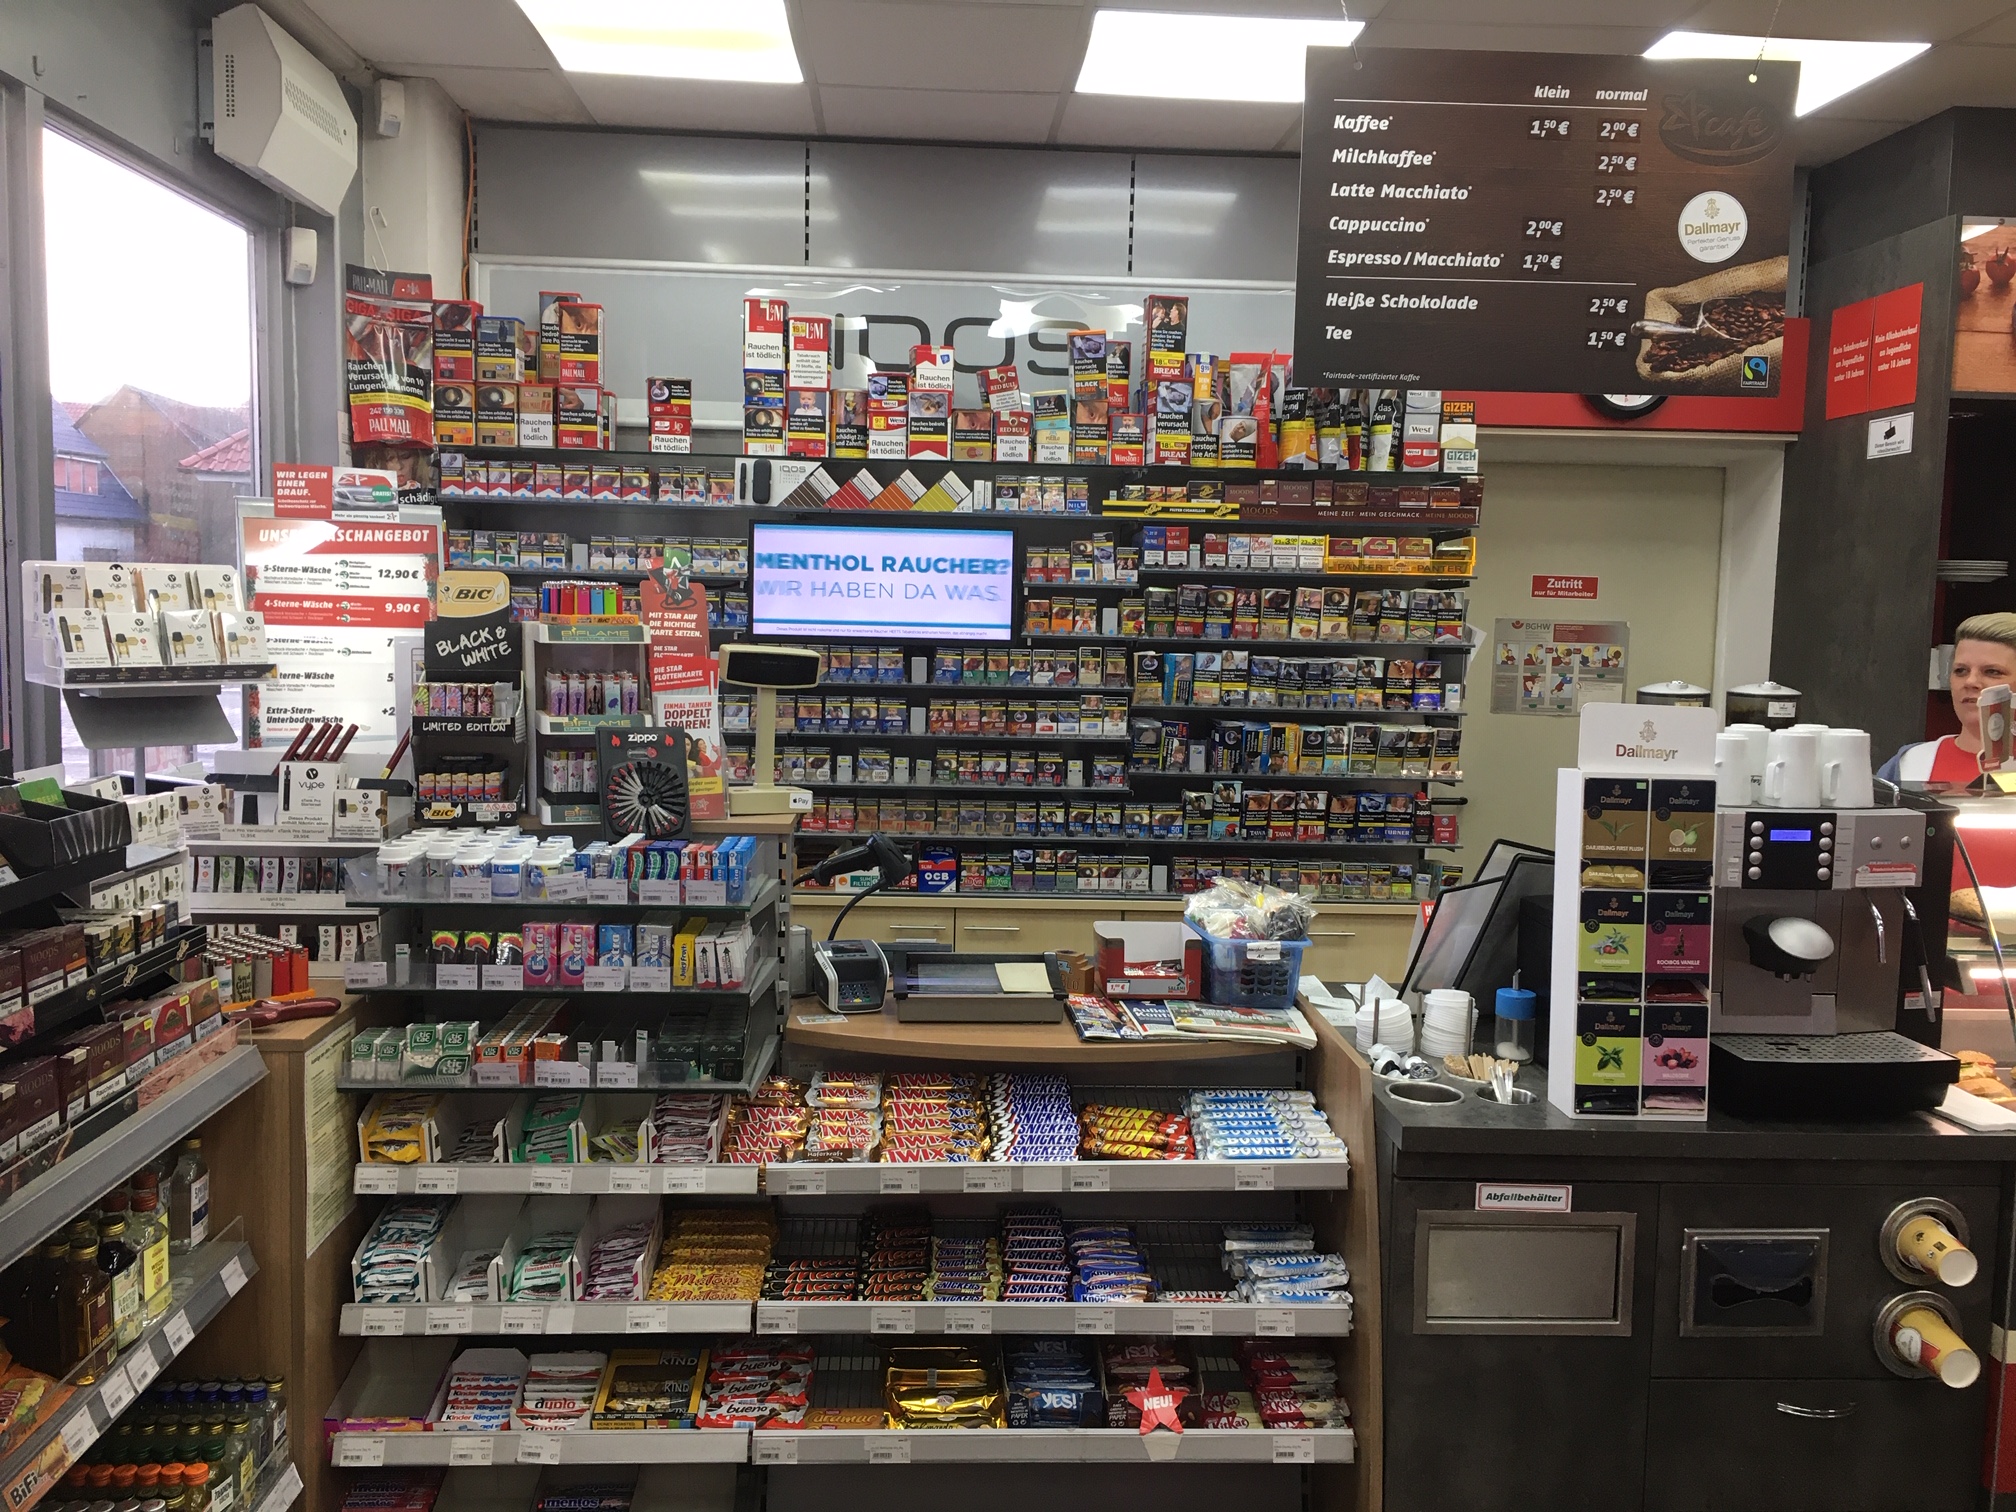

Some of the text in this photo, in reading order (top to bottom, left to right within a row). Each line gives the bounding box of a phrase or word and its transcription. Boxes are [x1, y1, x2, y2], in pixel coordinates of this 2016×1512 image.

[1534, 84, 1648, 101] klein normal
[1330, 182, 1374, 198] Latte
[1684, 221, 1741, 236] Dallmayr
[1687, 237, 1716, 246] Perfekter
[1699, 243, 1729, 253] garantiert
[1325, 292, 1375, 310] Heiße
[1380, 293, 1478, 311] Schokolade
[1325, 325, 1352, 341] Tee
[1875, 334, 1885, 344] Kein
[747, 343, 780, 351] Rauchen
[1886, 342, 1912, 356] Jugendliche
[746, 351, 782, 360] ist tödlich
[1895, 356, 1912, 368] Jahren
[1153, 367, 1181, 376] BREAK
[1399, 373, 1420, 383] Kaffee
[1075, 380, 1099, 388] BLACK
[1743, 379, 1767, 388] FAIRTRADE
[1443, 402, 1474, 412] GIZEH
[1157, 412, 1184, 421] Rauchen
[520, 418, 552, 427] Rauchen
[1157, 420, 1189, 429] verursacht
[530, 426, 541, 434] ist
[1157, 428, 1191, 436] Herzanfälle
[523, 433, 549, 441] tödlich
[653, 436, 688, 446] Rauchen
[652, 444, 691, 453] ist tödlich
[871, 439, 904, 448] Rauchen
[869, 447, 906, 456] ist tödlich
[1159, 450, 1187, 459] BREAK
[1446, 450, 1477, 461] GIZEH
[779, 465, 807, 473] IQOS
[276, 471, 328, 480] WIR LEGEN
[276, 480, 306, 488] EINEN
[277, 487, 311, 497] DRAUF.
[371, 490, 392, 498] GRATIS!
[755, 552, 1010, 576] MENTHOL RAUCHER?
[1417, 564, 1463, 573] PANTER
[263, 564, 332, 575] 5-Sterne-Wäsche
[377, 569, 410, 580] 12,90
[411, 570, 419, 579] €
[1547, 578, 1583, 589] Zutritt
[756, 579, 1002, 602] WIR HABEN DA WAS
[1557, 590, 1595, 598] Mitarbeiter
[264, 600, 333, 610] 4-Sterne-Wäsche
[385, 602, 411, 614] 9,90
[413, 604, 421, 614] €
[648, 611, 698, 621] MIT STAR AUF
[649, 620, 697, 629] DIE RICHTIGE
[1525, 623, 1552, 631] BGHW
[649, 628, 703, 638] KARTE SETZEN.
[435, 625, 508, 657] BLACK &
[461, 641, 512, 668] WHITE
[653, 664, 683, 674] DIE STAR
[654, 669, 703, 682] FLOTTENKARTE
[266, 706, 316, 715] Extra-Stern-
[663, 701, 713, 710] EINMAL TANKEN
[664, 708, 712, 720] DOPPELT
[422, 721, 507, 733] LIMITED EDITION
[664, 719, 711, 730] SPAREN!
[627, 733, 657, 744] zippo
[1615, 743, 1679, 762] Dallmayr
[298, 780, 325, 791] vype
[797, 797, 810, 806] Pay
[924, 871, 950, 882] OCB
[1018, 1123, 1080, 1135] SNICKERS
[1485, 1190, 1563, 1205] Abfallbehälter
[659, 1356, 698, 1365] KIND
[534, 1399, 576, 1412] duplo
[1042, 1392, 1078, 1409] YES!
[1143, 1395, 1174, 1411] NEU!
[726, 1403, 769, 1415] bueno
